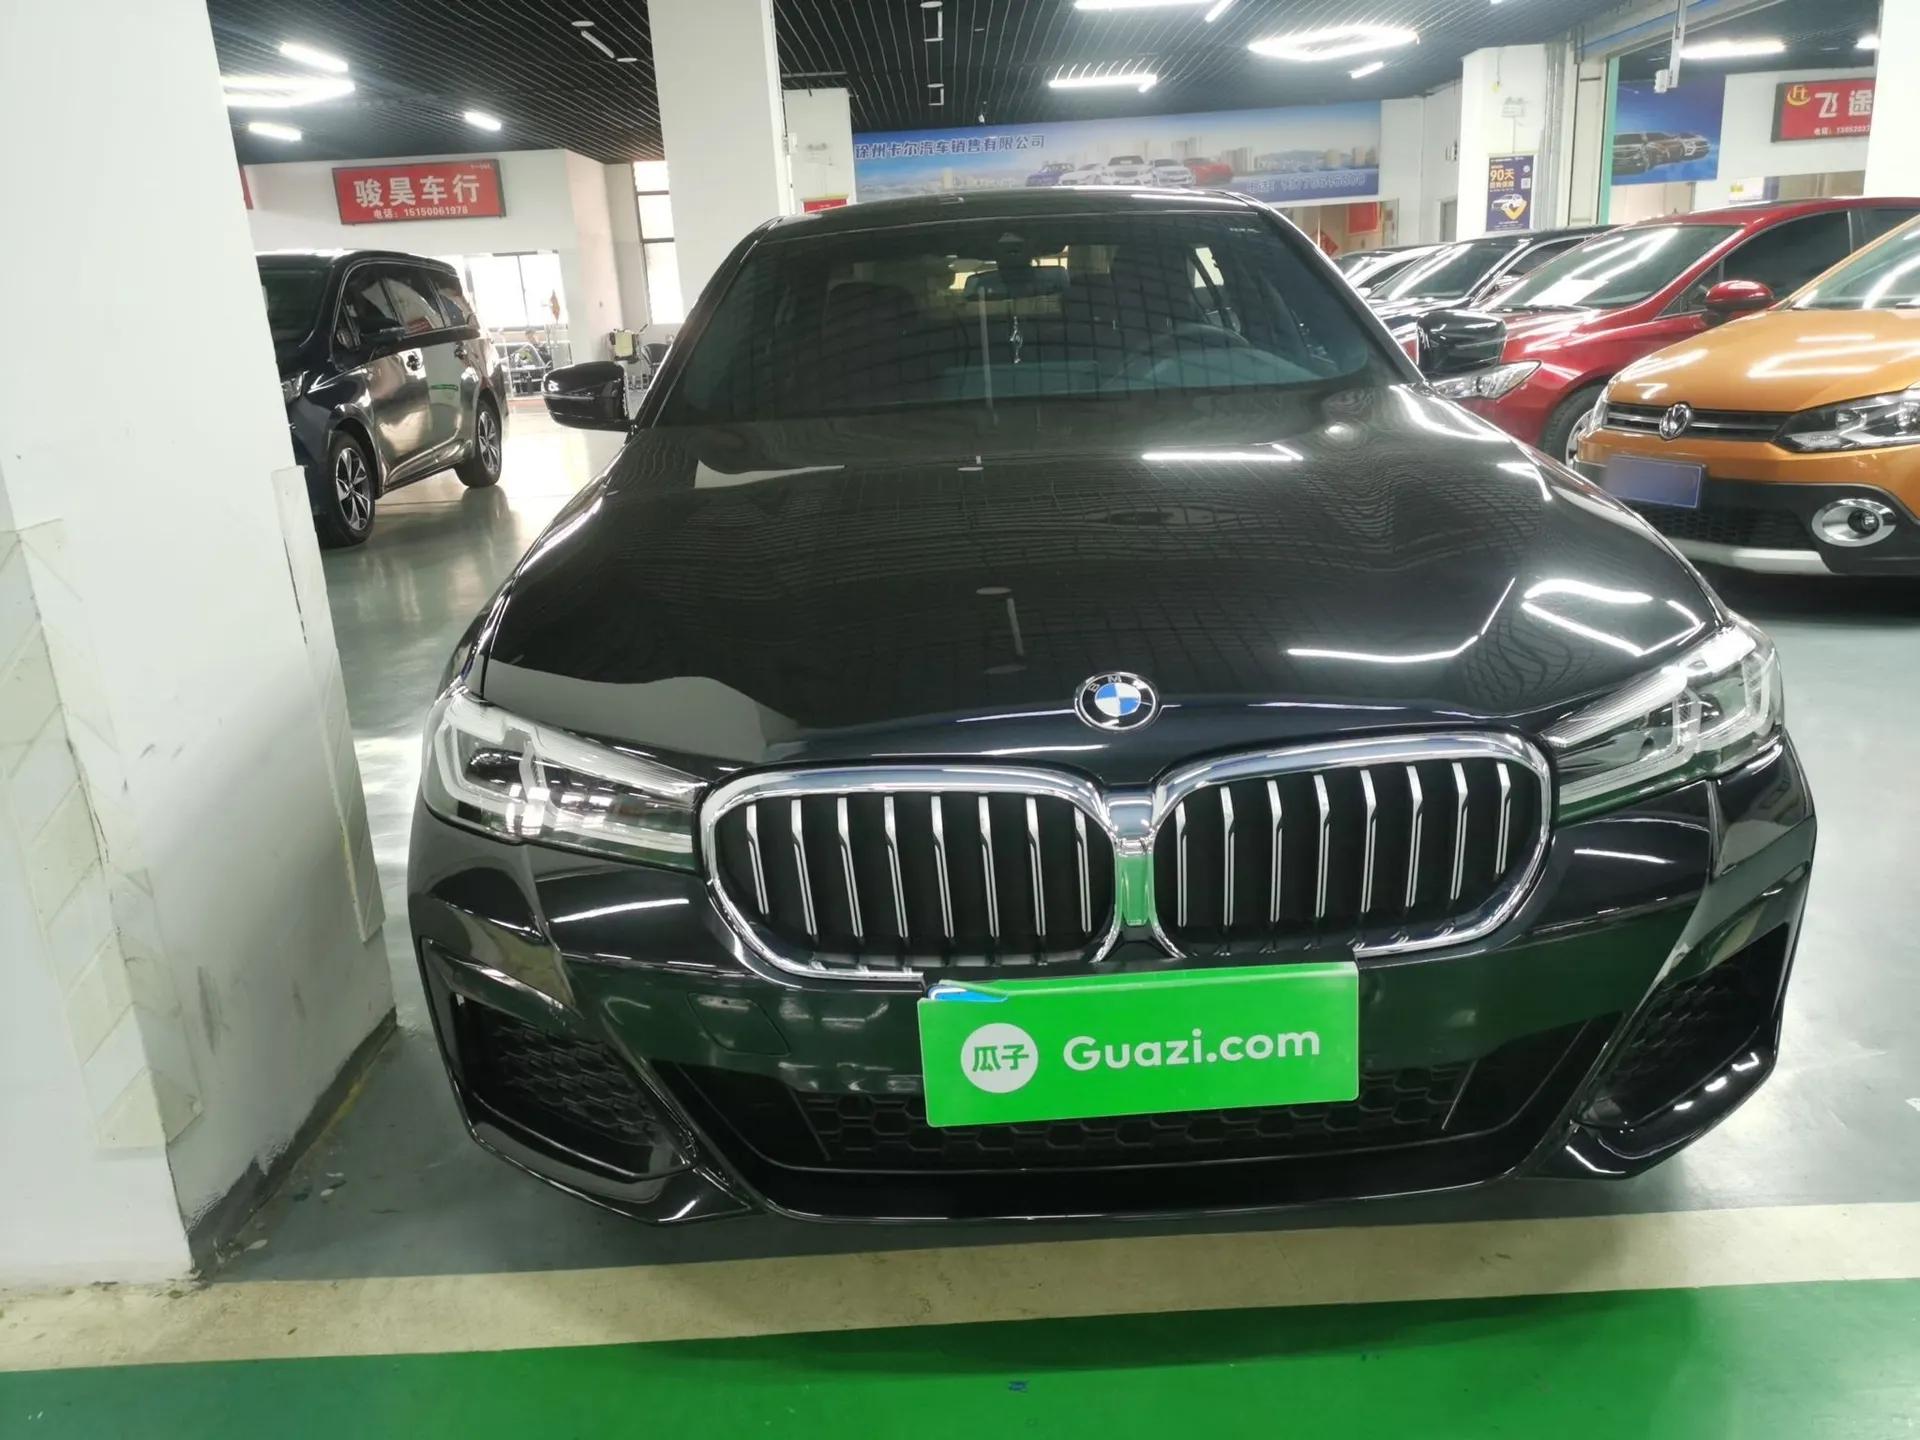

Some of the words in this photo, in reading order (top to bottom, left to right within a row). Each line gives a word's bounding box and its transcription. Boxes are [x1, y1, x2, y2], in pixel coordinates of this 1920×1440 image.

[1814, 88, 1873, 118] 飞途
[855, 135, 1045, 160] 徐州卡尔汽车销售有限公司
[353, 174, 480, 208] 骏昊车行
[972, 1044, 1030, 1072] 瓜子
[1063, 1028, 1320, 1071] Guazi.com
